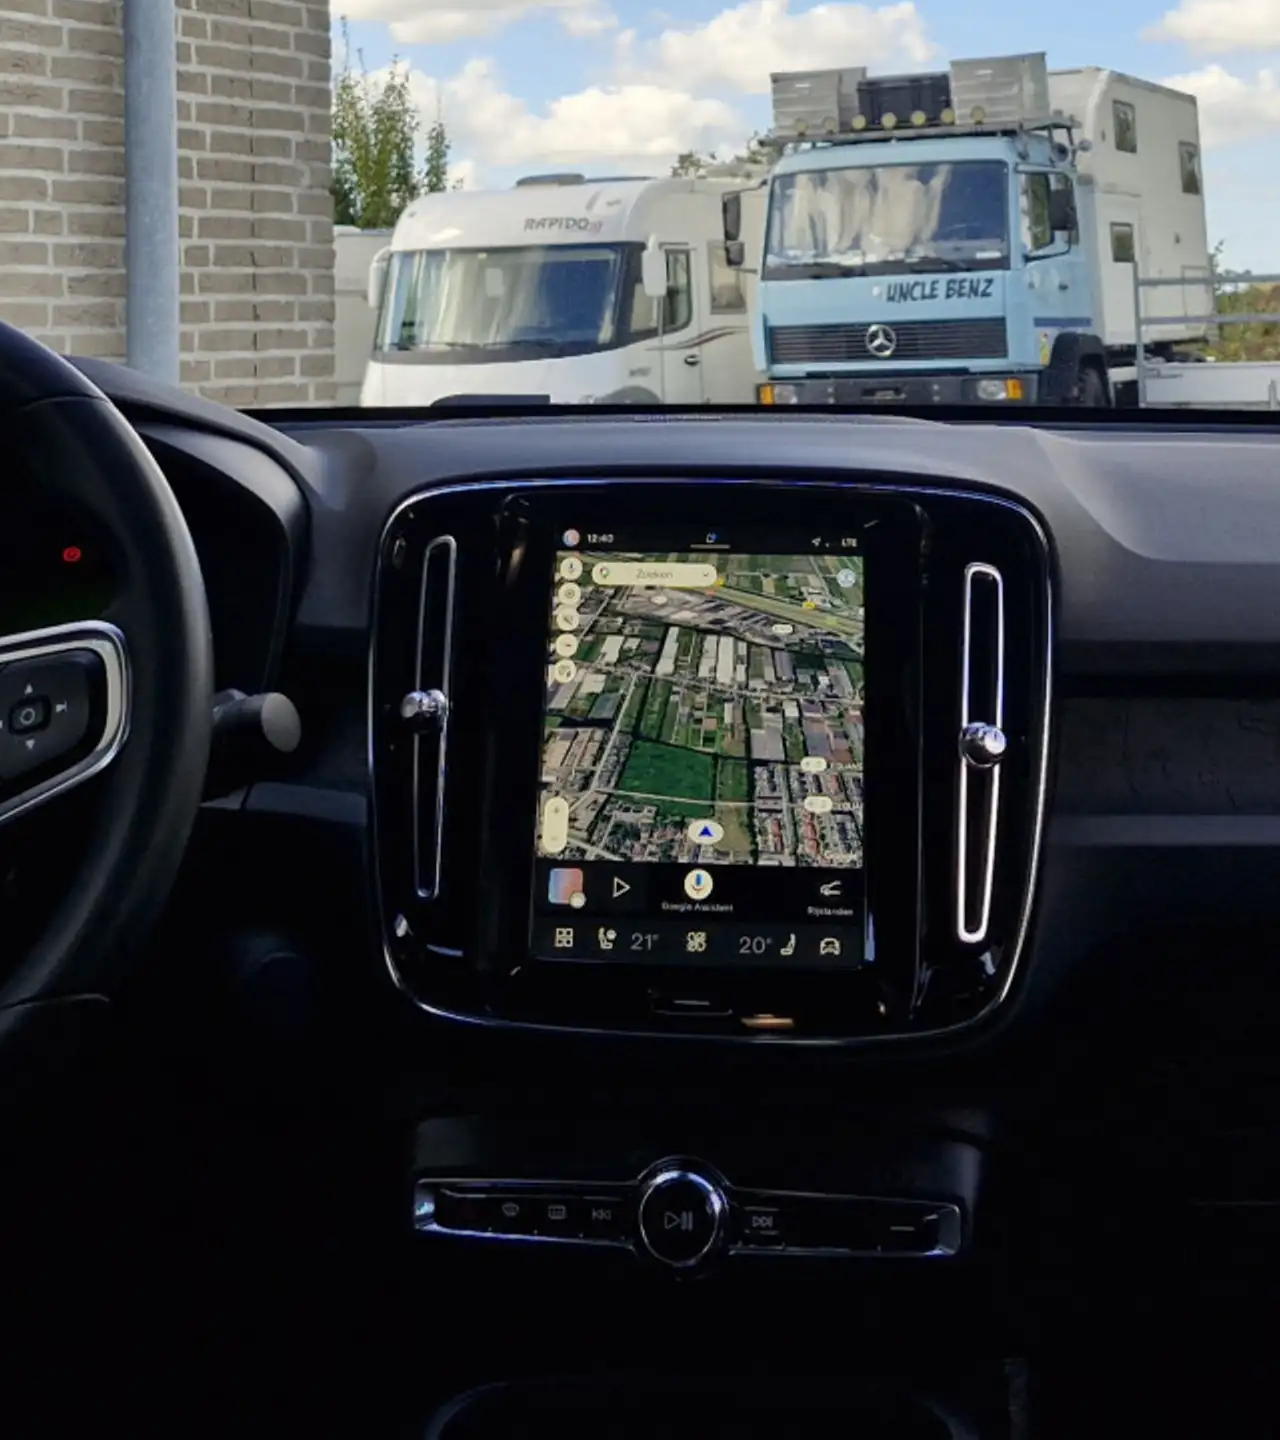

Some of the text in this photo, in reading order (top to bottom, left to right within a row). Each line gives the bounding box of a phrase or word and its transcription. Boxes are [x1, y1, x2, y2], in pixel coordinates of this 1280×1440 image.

[523, 216, 590, 231] RAPIDO
[886, 277, 995, 303] UNCLE BENZ
